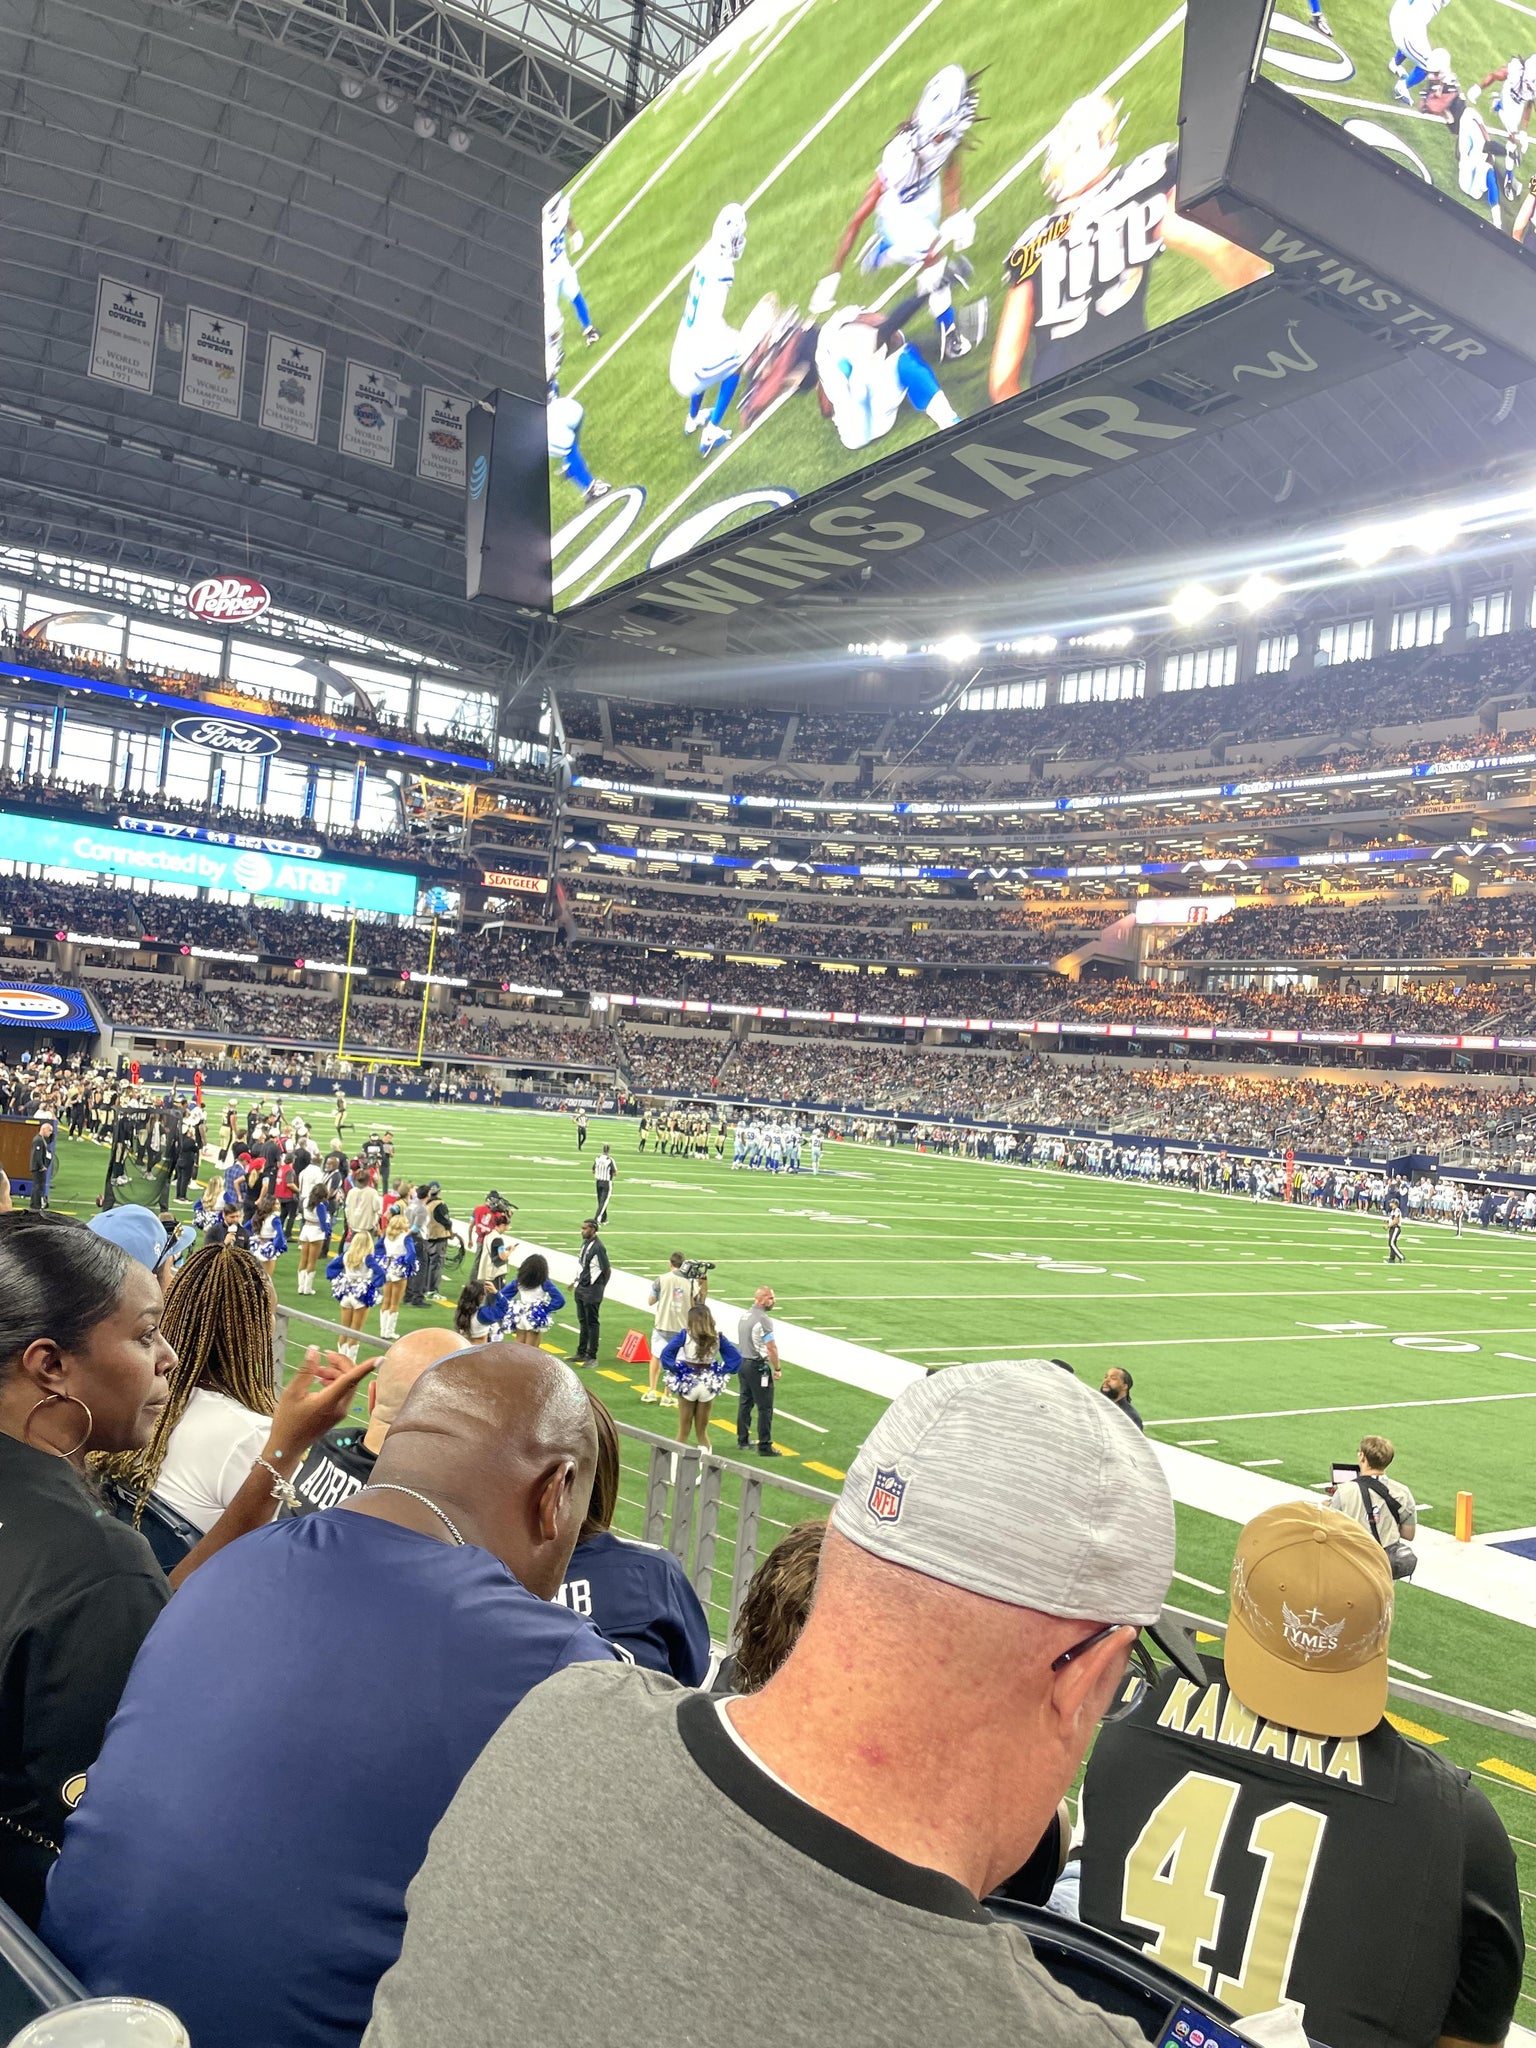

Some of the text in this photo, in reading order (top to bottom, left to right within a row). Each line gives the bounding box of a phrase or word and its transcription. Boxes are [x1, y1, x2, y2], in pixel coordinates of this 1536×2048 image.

[1260, 229, 1487, 361] WINSTAR
[108, 310, 146, 328] COWBOYS
[113, 303, 144, 319] DALLAS
[197, 339, 234, 356] COWBOYS
[201, 333, 230, 347] DALLAS
[106, 350, 140, 367] WORLD
[281, 358, 309, 372] DALLAS
[96, 356, 148, 380] CHAMPIONS
[277, 364, 312, 380] COWBOYS
[196, 379, 228, 394] WORLD
[358, 384, 385, 398] DALLAS
[186, 385, 236, 406] CHAMPIONS
[354, 391, 386, 405] COWBOY
[276, 403, 306, 418] WORLD
[434, 410, 460, 422] DALLAS
[266, 409, 314, 430] CHAMPIONS
[431, 416, 462, 430] COWBOYS
[354, 428, 382, 442] WORLD
[431, 453, 458, 466] WORLD
[636, 395, 1197, 615] WINSTAR
[220, 579, 252, 599] Dr
[194, 579, 265, 617] Pepper
[192, 722, 262, 752] Ford
[1400, 808, 1422, 816] CHUCK
[1423, 805, 1451, 814] HOWLEY
[73, 836, 196, 873] Connected
[199, 854, 228, 882] by
[274, 864, 347, 896] AT&T
[488, 874, 539, 891] SEATGEEK
[872, 1488, 896, 1516] NFL
[1282, 1622, 1338, 1650] TYMES
[1156, 1677, 1363, 1786] KAMARA
[1120, 1771, 1327, 2014] 41
